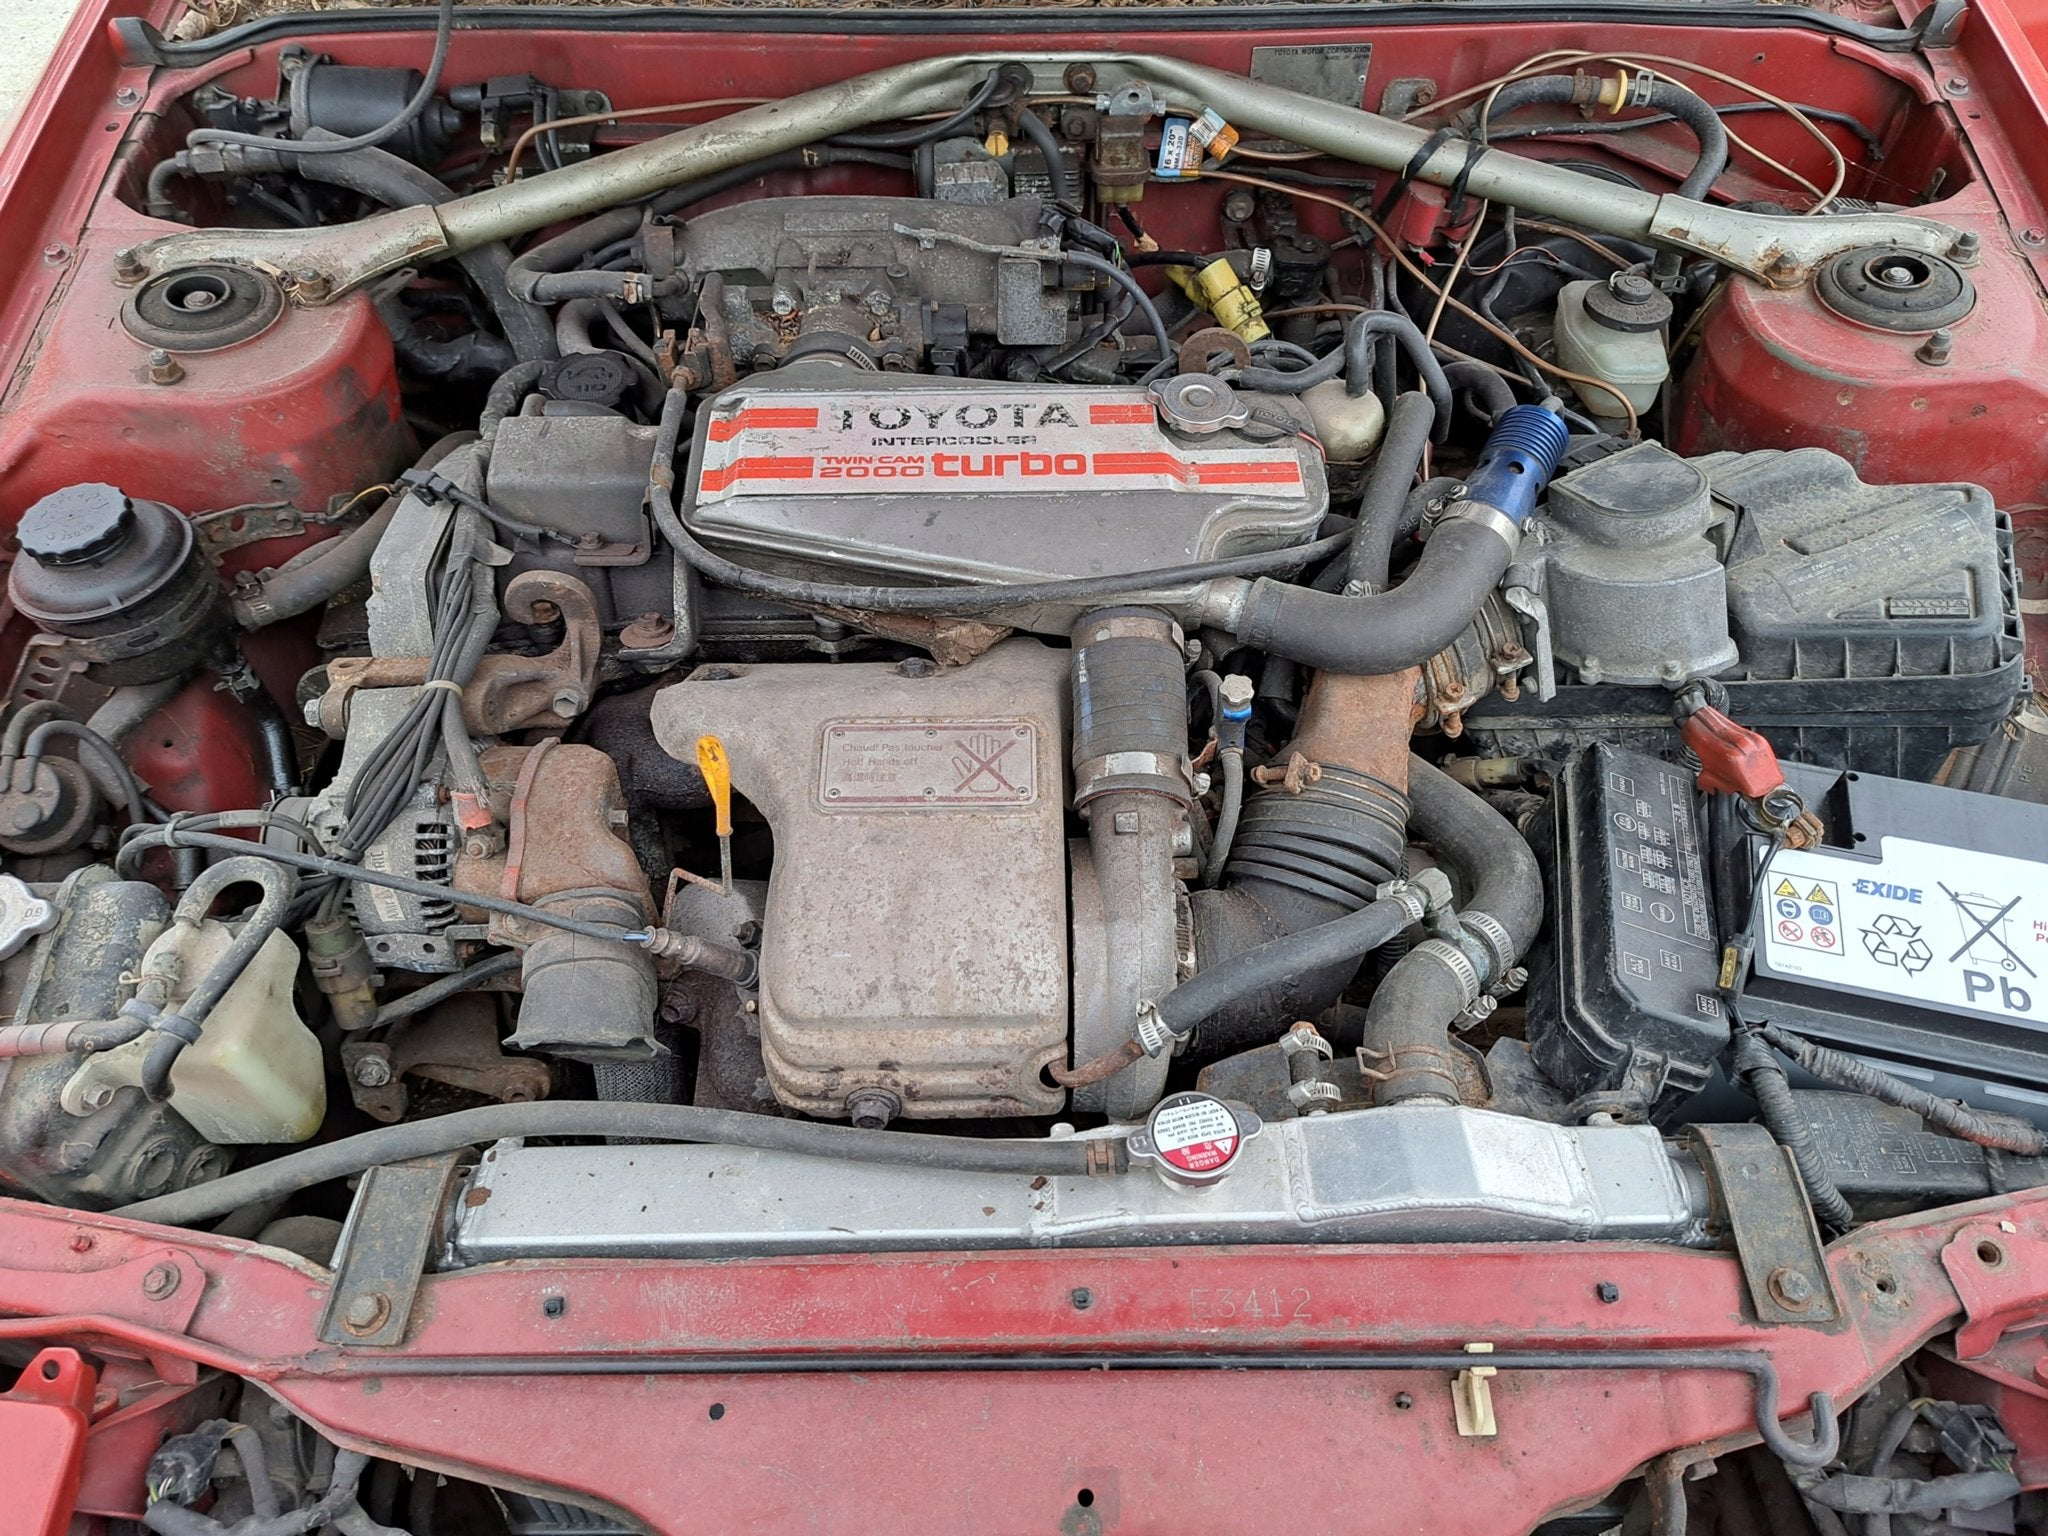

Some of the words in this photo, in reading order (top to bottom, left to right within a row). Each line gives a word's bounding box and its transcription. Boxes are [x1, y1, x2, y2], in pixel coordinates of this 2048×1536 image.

[1326, 46, 1370, 54] CORPORATION
[831, 402, 1079, 431] TOYOTA
[1257, 409, 1297, 427] TOYOTA
[871, 435, 1037, 447] INTERCOOLER
[820, 456, 874, 465] TWIN
[877, 455, 925, 465] CAM
[931, 451, 1087, 478] turbo
[819, 465, 925, 479] 2000
[1399, 514, 1418, 533] SAE
[1893, 600, 1968, 608] TOYOTA
[841, 743, 879, 752] Chaud!
[881, 743, 901, 752] Pas
[868, 757, 900, 766] Hands
[902, 757, 918, 766] off
[1681, 877, 1692, 905] NOTICE
[1853, 878, 1922, 905] EXIDE
[1963, 968, 2033, 1013] Pb
[1178, 1097, 1191, 1106] 1.1
[1186, 1150, 1218, 1162] WARNING
[1189, 1156, 1220, 1169] DANGER
[1190, 1287, 1313, 1320] E3412
